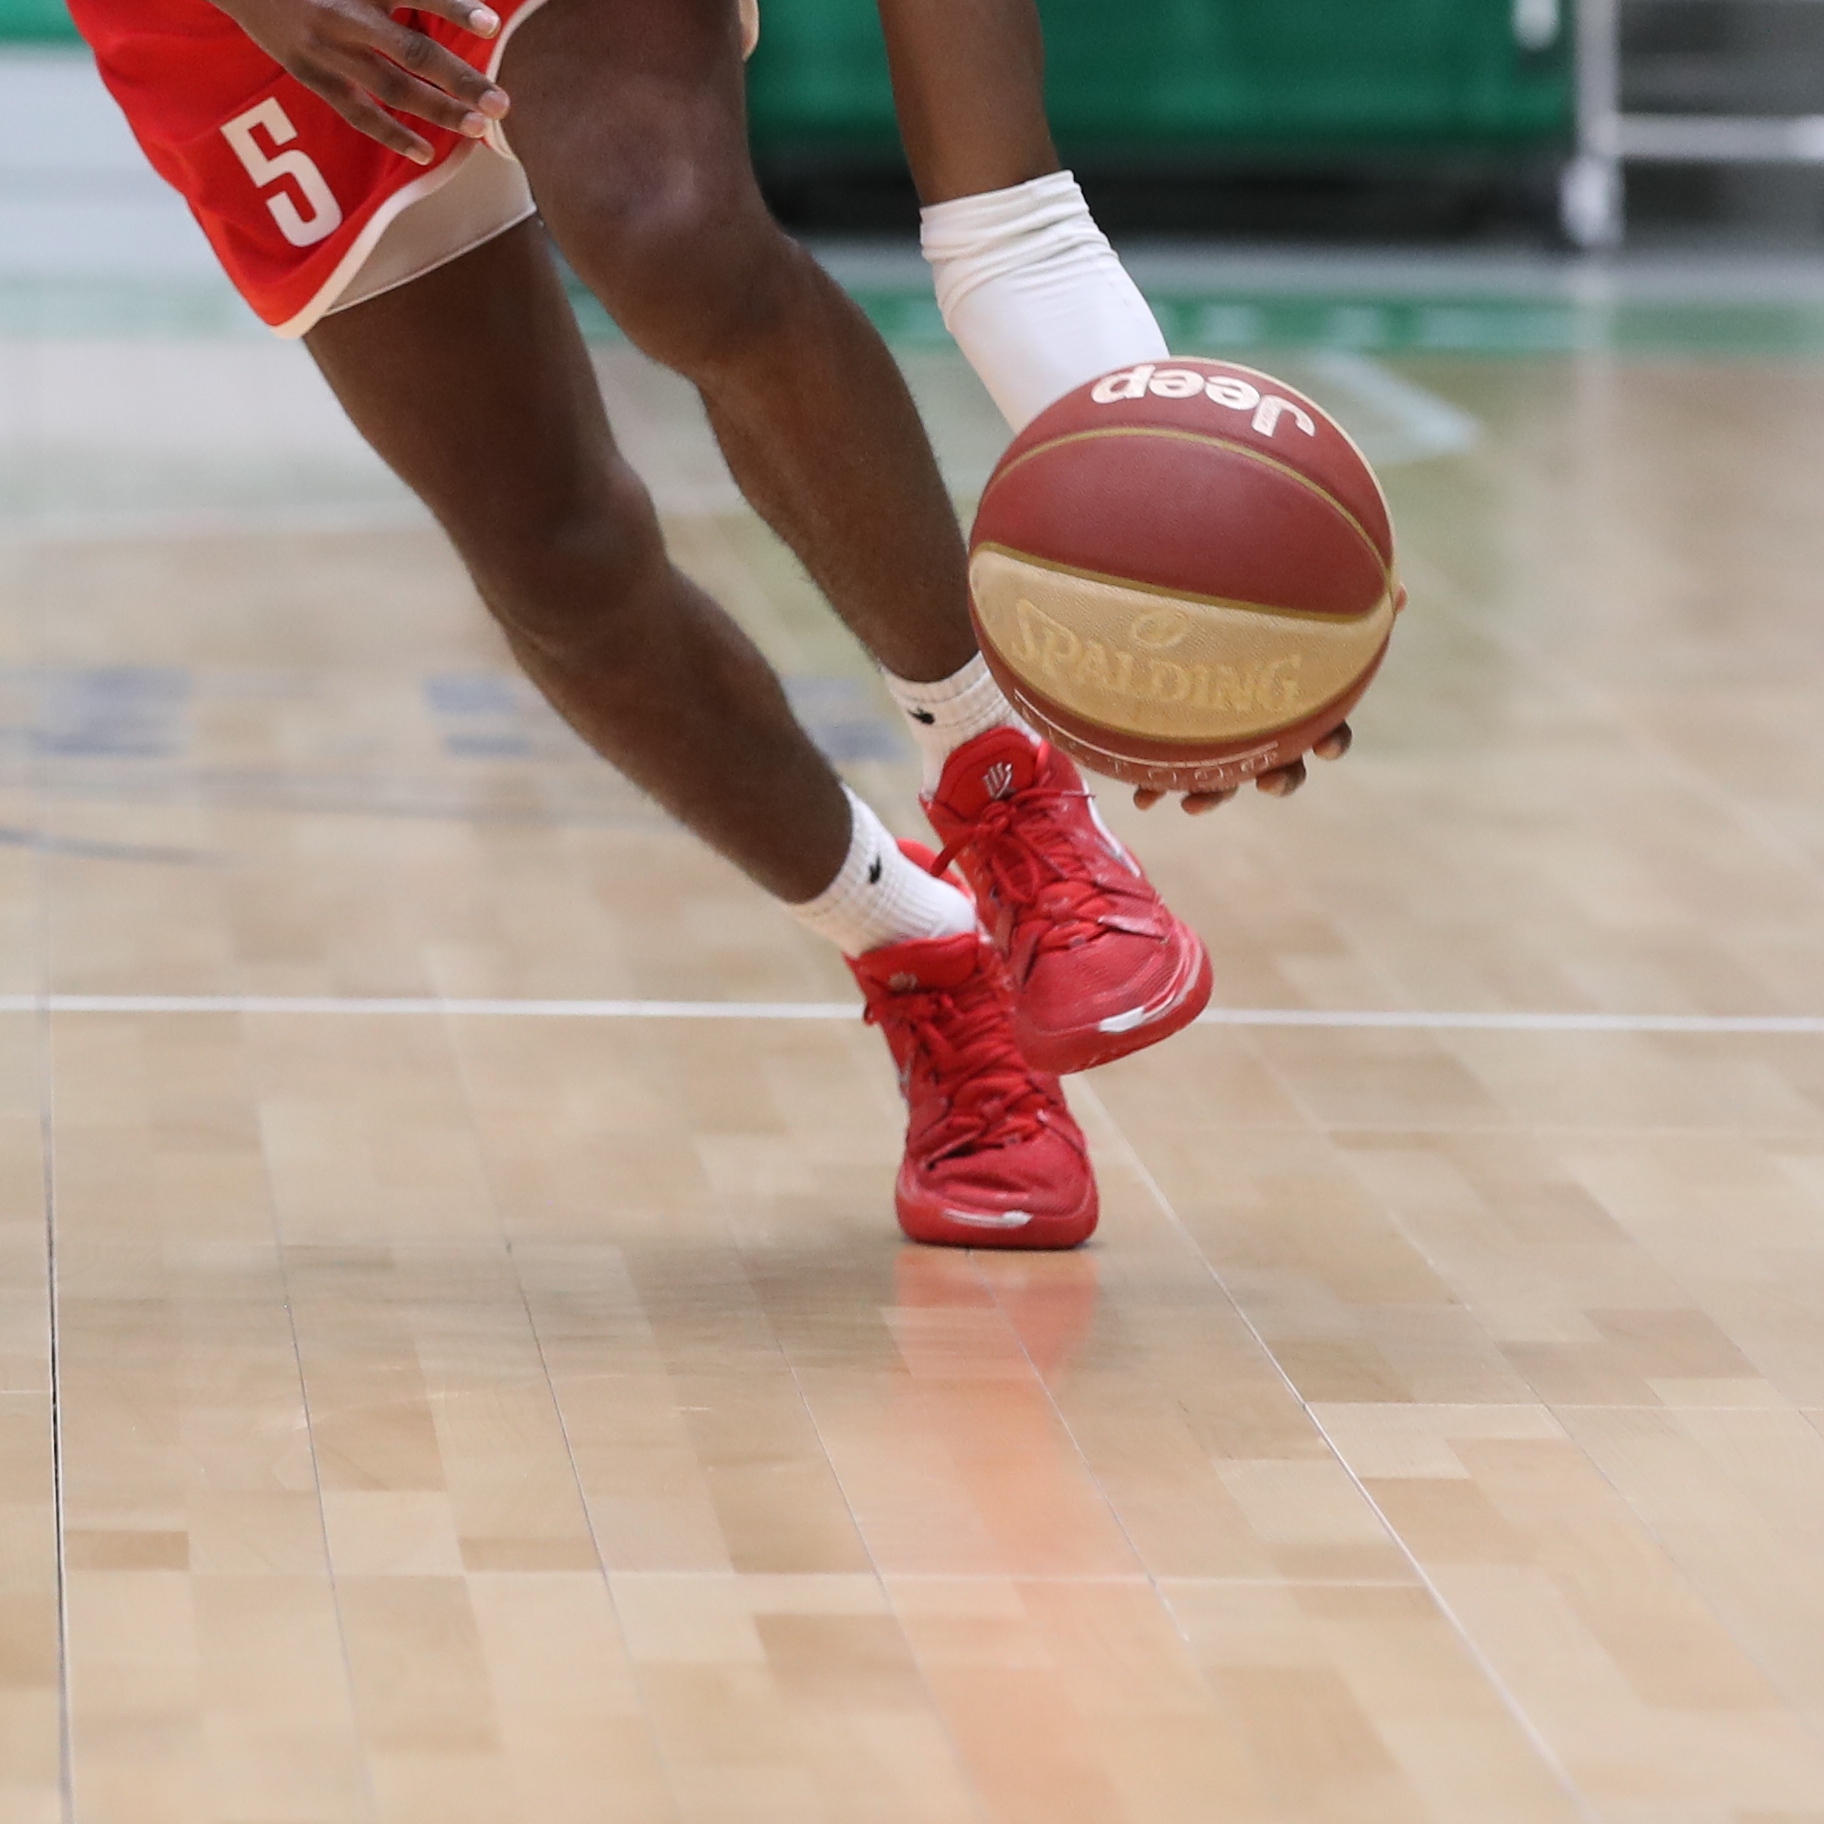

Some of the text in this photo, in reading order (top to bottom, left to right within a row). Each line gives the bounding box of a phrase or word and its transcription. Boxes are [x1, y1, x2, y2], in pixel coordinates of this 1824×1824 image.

[219, 96, 344, 248] 5
[1091, 364, 1316, 438] Jeep
[1011, 599, 1303, 713] SPALDING
